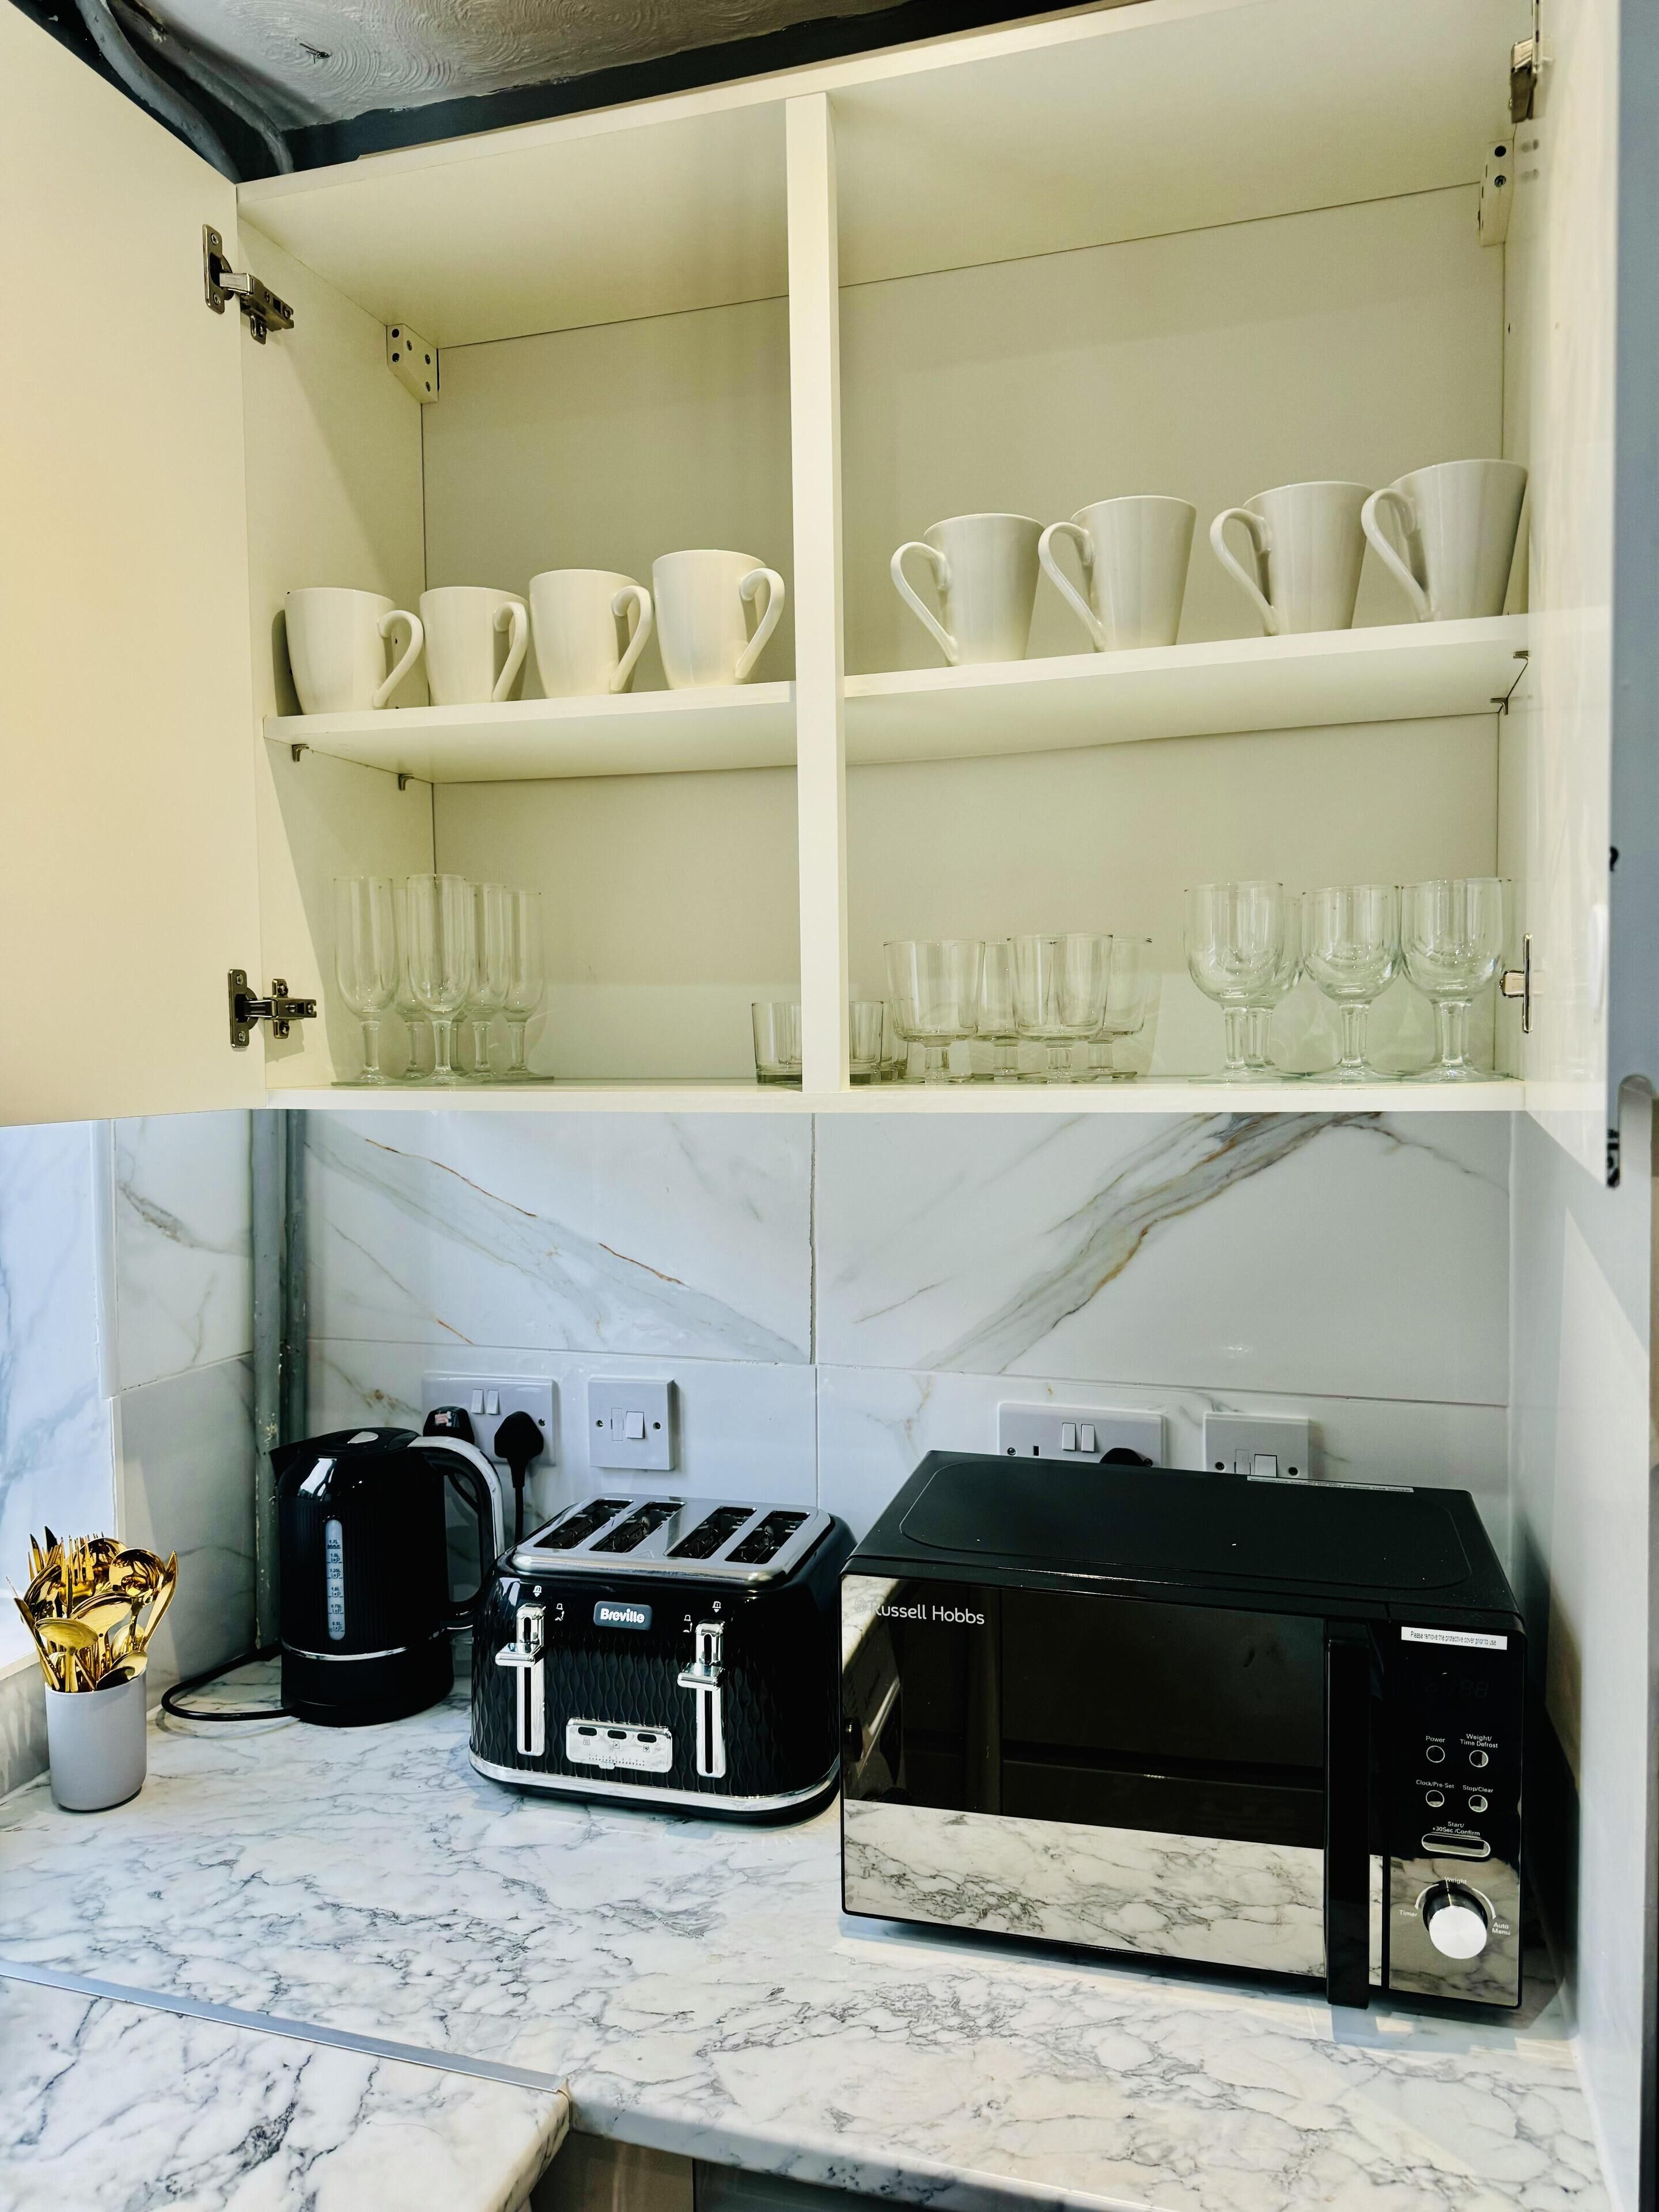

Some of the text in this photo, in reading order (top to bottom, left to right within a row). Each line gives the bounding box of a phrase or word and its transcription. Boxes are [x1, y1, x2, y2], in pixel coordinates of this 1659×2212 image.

[600, 1608, 645, 1623] Breville
[870, 1599, 985, 1625] Russell Hobbs
[1426, 1735, 1445, 1743] Power
[1466, 1733, 1492, 1742] Weight/
[1476, 1740, 1498, 1749] Defrost
[1416, 1779, 1455, 1789] Clock/Pre-Set
[1463, 1785, 1494, 1793] Stop/Clear
[1444, 1876, 1467, 1885] Weight
[1399, 1909, 1418, 1918] Timer
[1493, 1922, 1509, 1930] Auto
[1491, 1928, 1511, 1936] Menu
